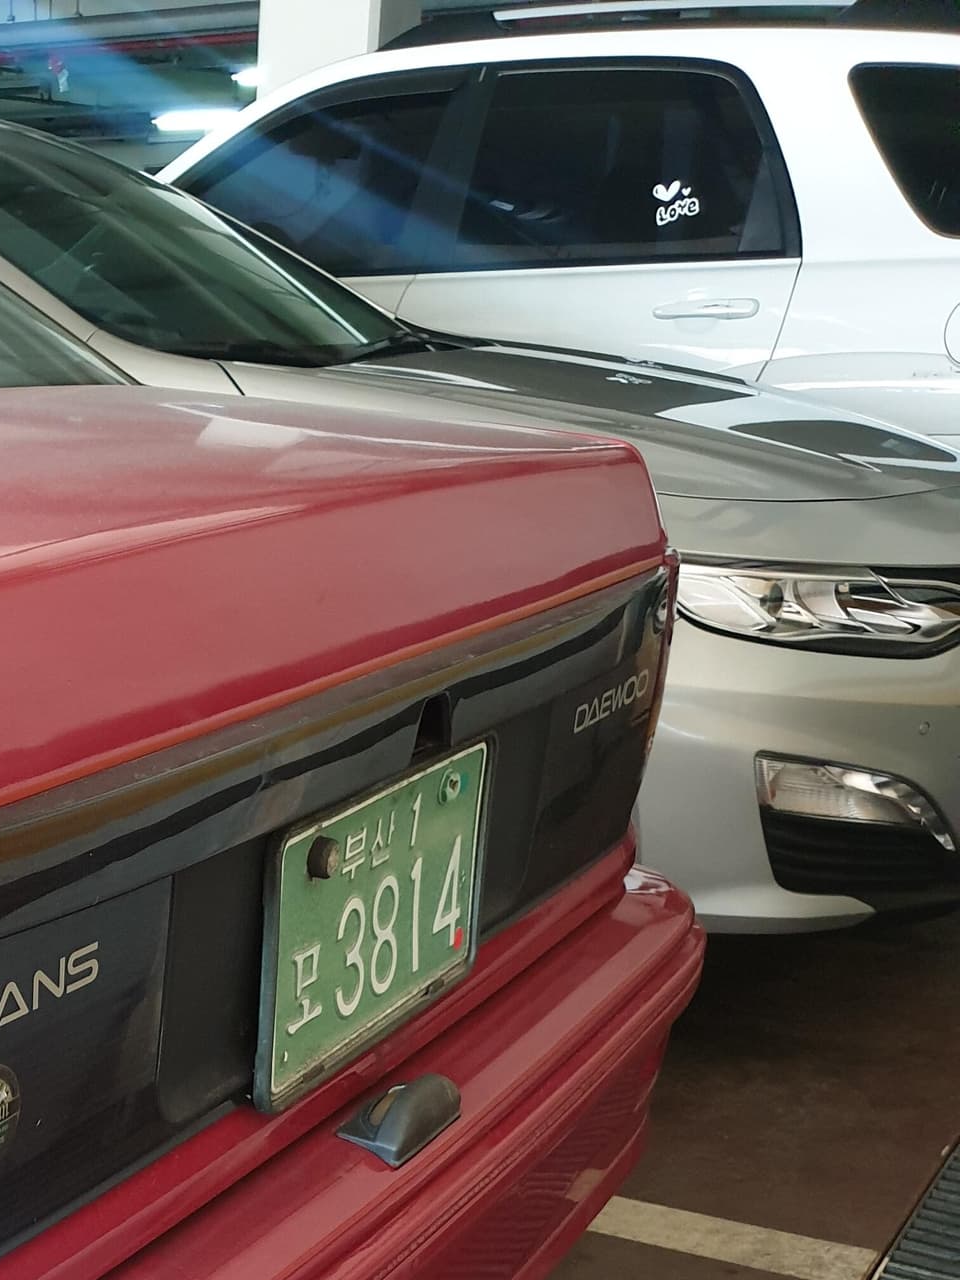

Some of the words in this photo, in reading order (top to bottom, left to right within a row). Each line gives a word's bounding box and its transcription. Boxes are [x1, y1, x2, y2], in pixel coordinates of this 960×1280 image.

[573, 669, 649, 734] DAEWOO
[342, 810, 396, 881] 부산
[410, 792, 422, 847] 1
[336, 834, 462, 1018] 3814
